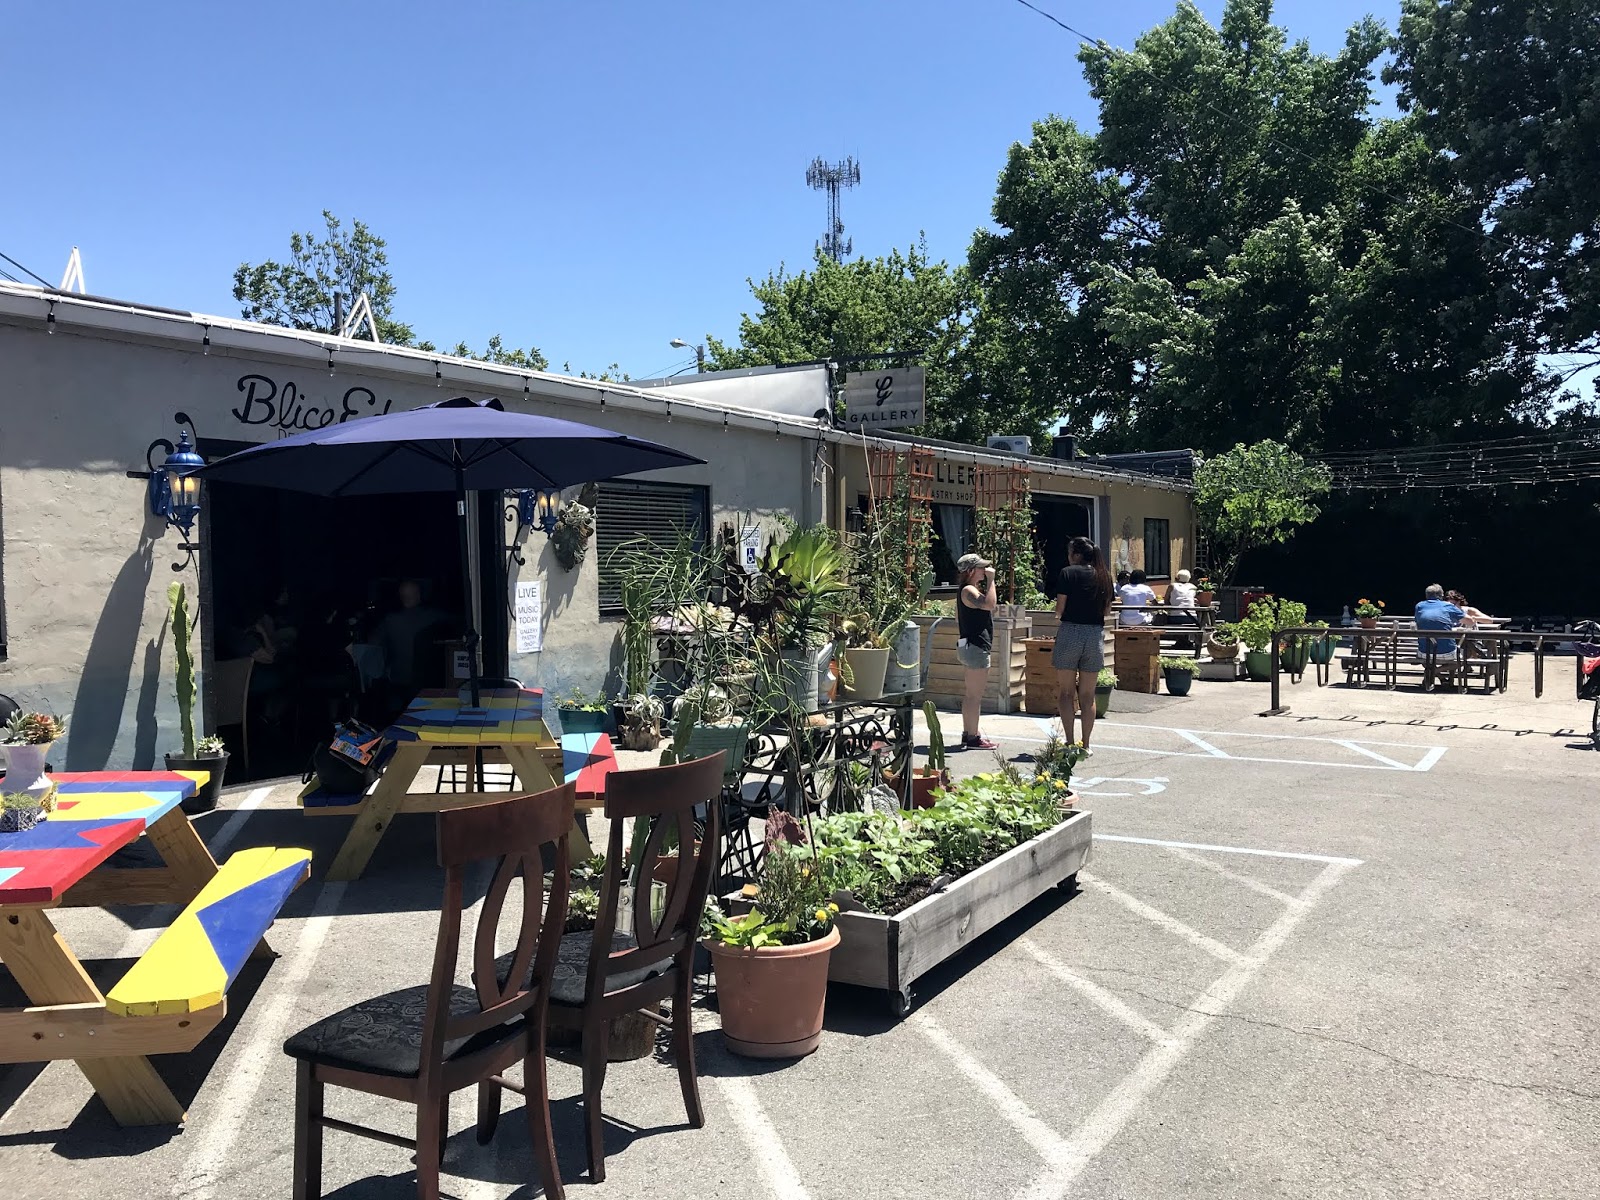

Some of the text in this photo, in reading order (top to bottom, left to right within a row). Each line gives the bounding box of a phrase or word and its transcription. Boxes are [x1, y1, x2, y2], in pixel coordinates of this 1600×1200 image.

[232, 375, 335, 430] Blice
[850, 409, 918, 423] GALLERY
[931, 490, 974, 501] ASTRY SHOP
[518, 587, 537, 598] LIVE
[518, 606, 539, 614] MUSIC
[993, 605, 1020, 618] PEN
